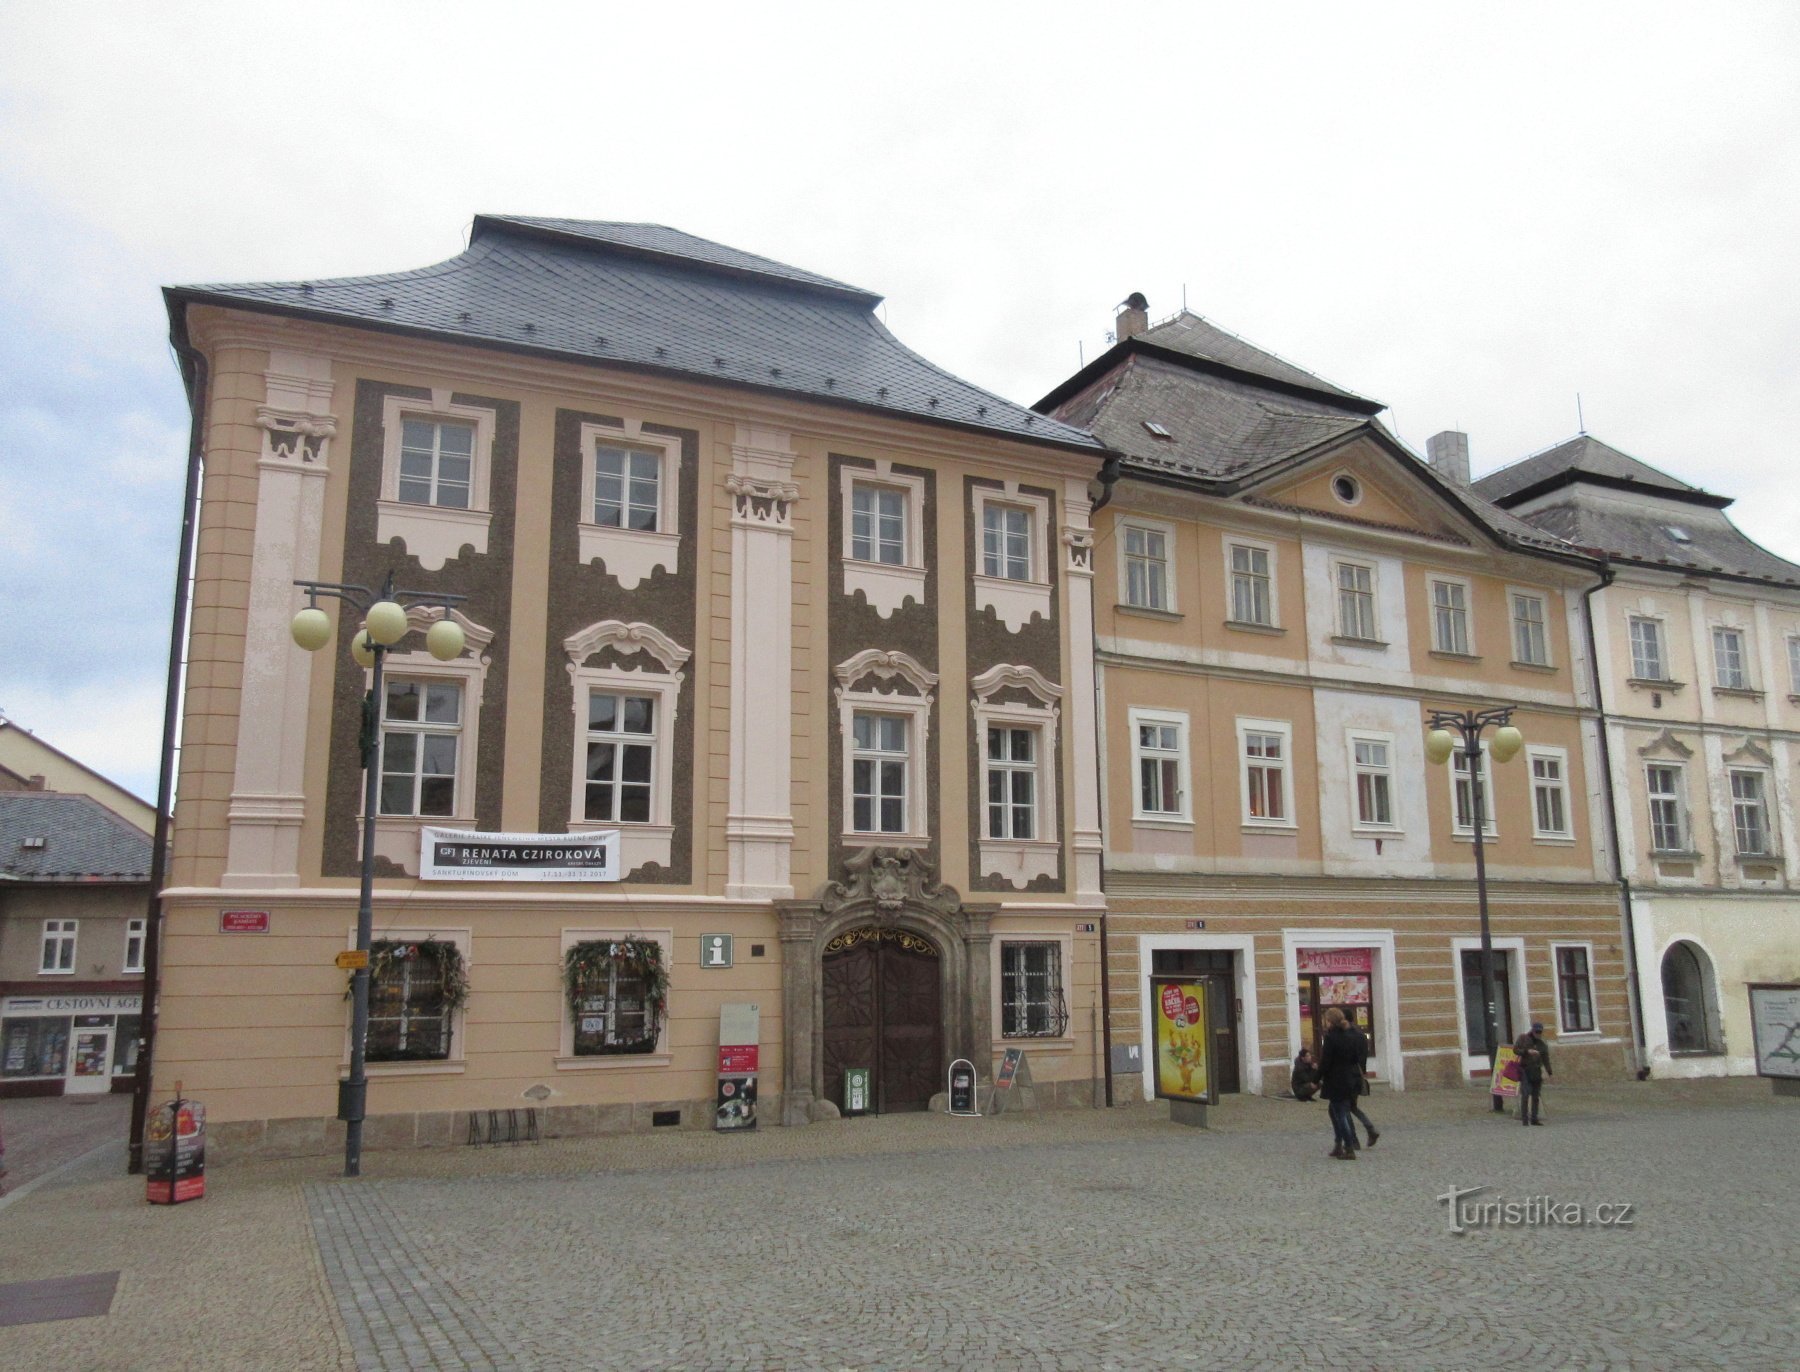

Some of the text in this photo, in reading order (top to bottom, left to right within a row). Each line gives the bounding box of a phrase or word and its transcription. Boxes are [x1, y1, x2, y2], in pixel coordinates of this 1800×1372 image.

[462, 848, 602, 860] RENATA CZIROKOVÁ
[1334, 957, 1361, 966] NAILS
[46, 997, 111, 1010] CESTOVNÍ
